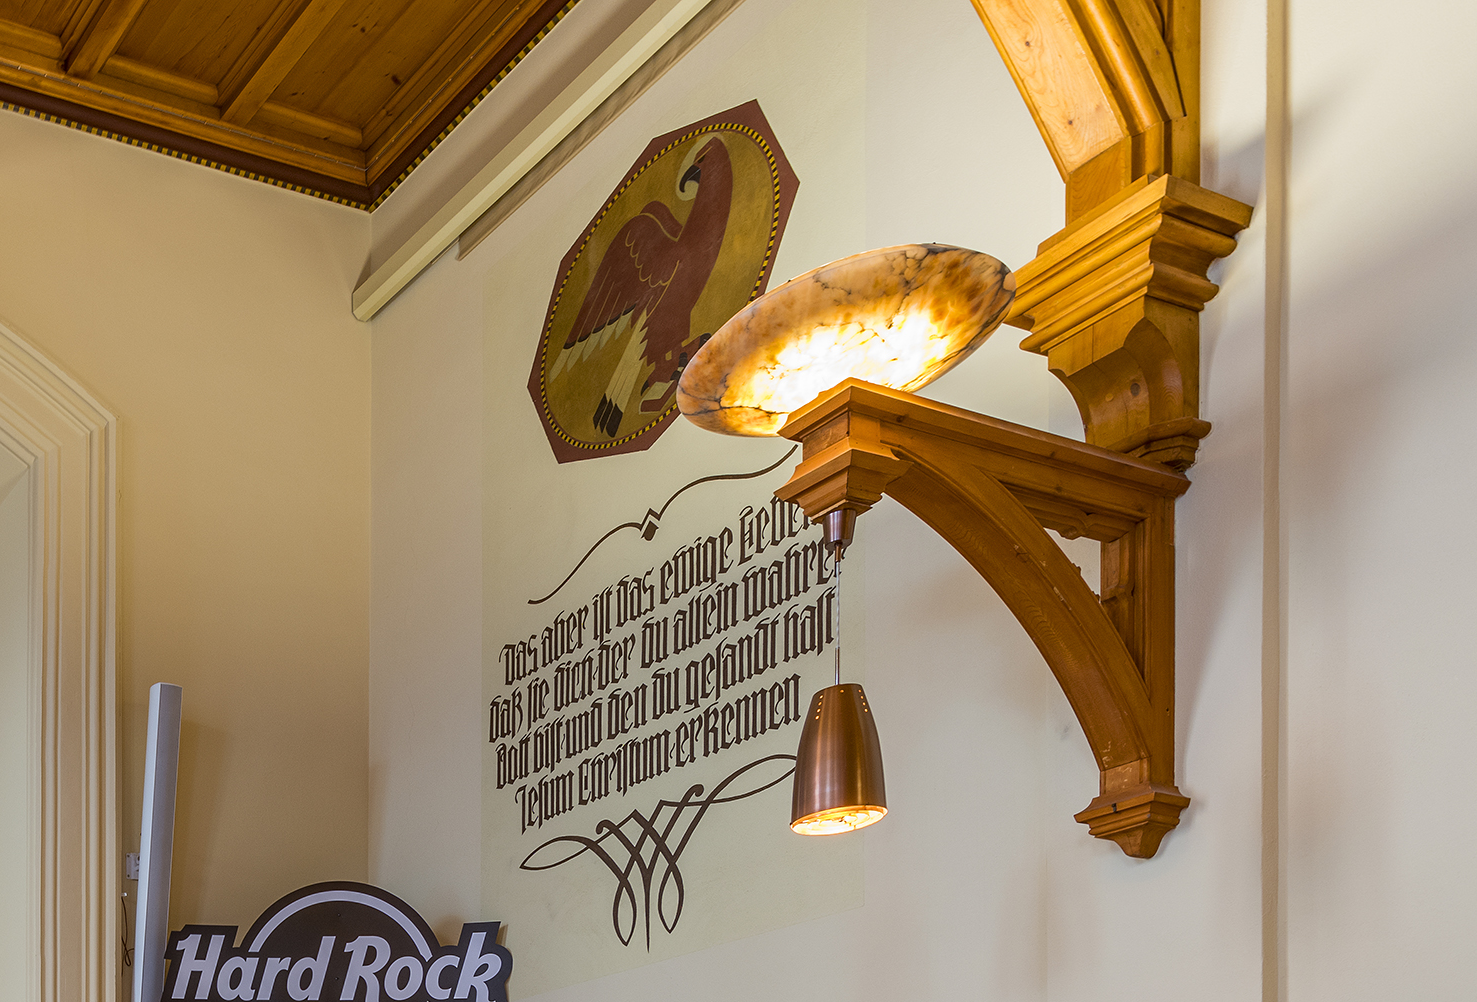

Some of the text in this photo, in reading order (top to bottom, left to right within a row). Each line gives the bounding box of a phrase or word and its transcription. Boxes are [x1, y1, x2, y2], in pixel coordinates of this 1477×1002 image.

[541, 605, 589, 668] aber
[616, 567, 655, 627] das
[660, 526, 734, 604] ewige
[737, 495, 810, 566] Lebe
[597, 633, 636, 690] der
[640, 616, 669, 668] du
[673, 582, 739, 655] allein
[565, 698, 603, 758] und
[607, 688, 648, 740] den
[651, 668, 681, 720] du
[675, 673, 802, 767] erkennen
[171, 933, 336, 1001] Hard
